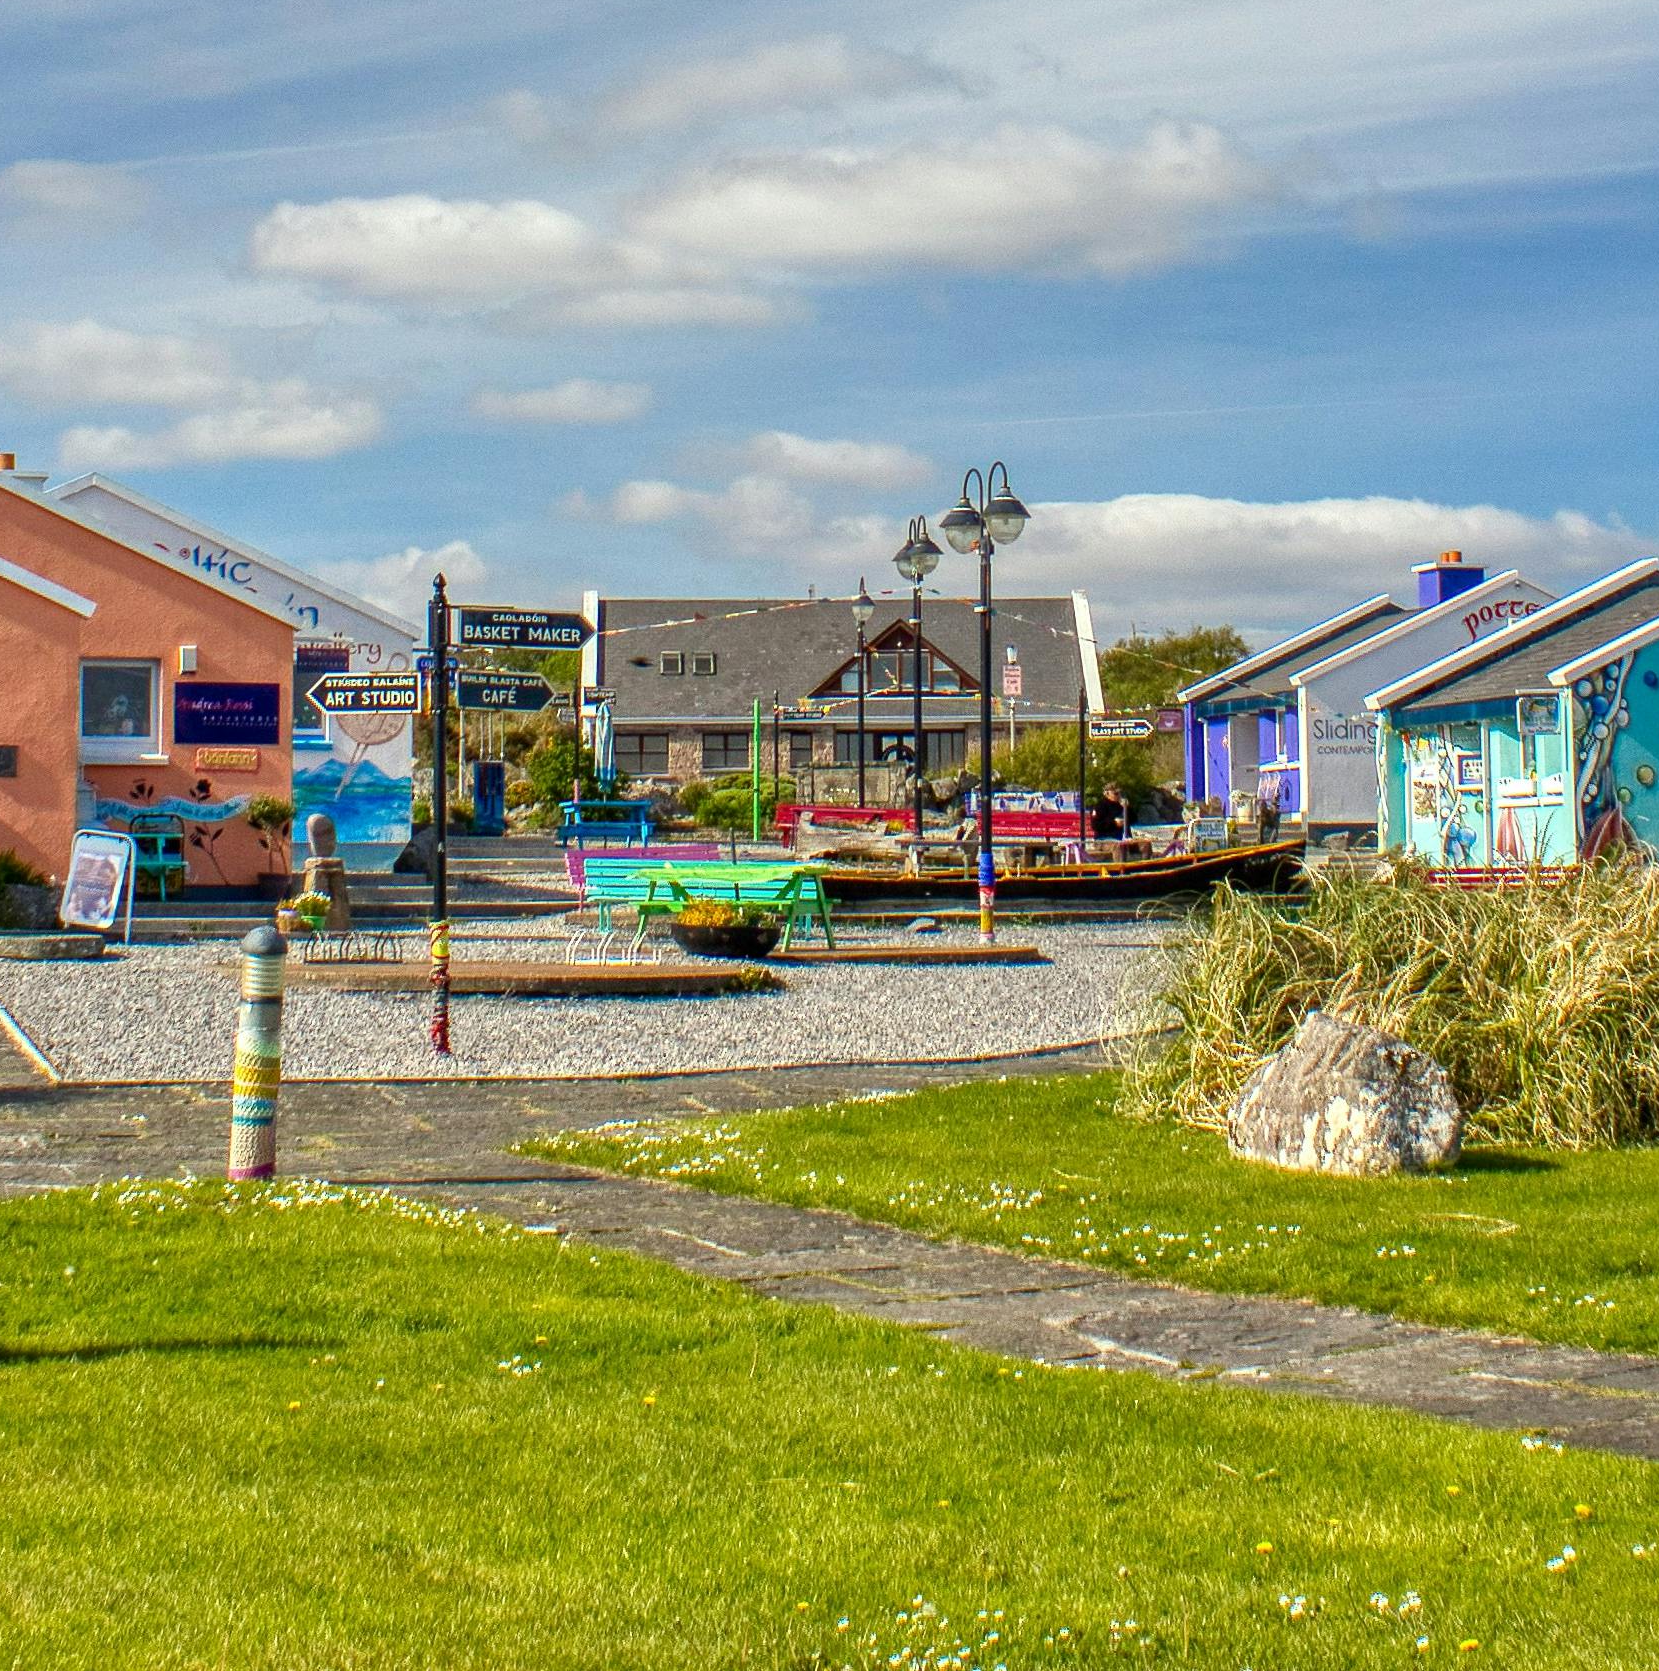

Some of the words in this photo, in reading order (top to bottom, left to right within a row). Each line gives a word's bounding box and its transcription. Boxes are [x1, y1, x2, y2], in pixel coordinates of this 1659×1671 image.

[463, 625, 521, 641] BASKET
[528, 627, 581, 643] MAKER
[325, 691, 355, 707] ART
[361, 690, 416, 706] STUDIO
[482, 685, 517, 705] CAFÉ
